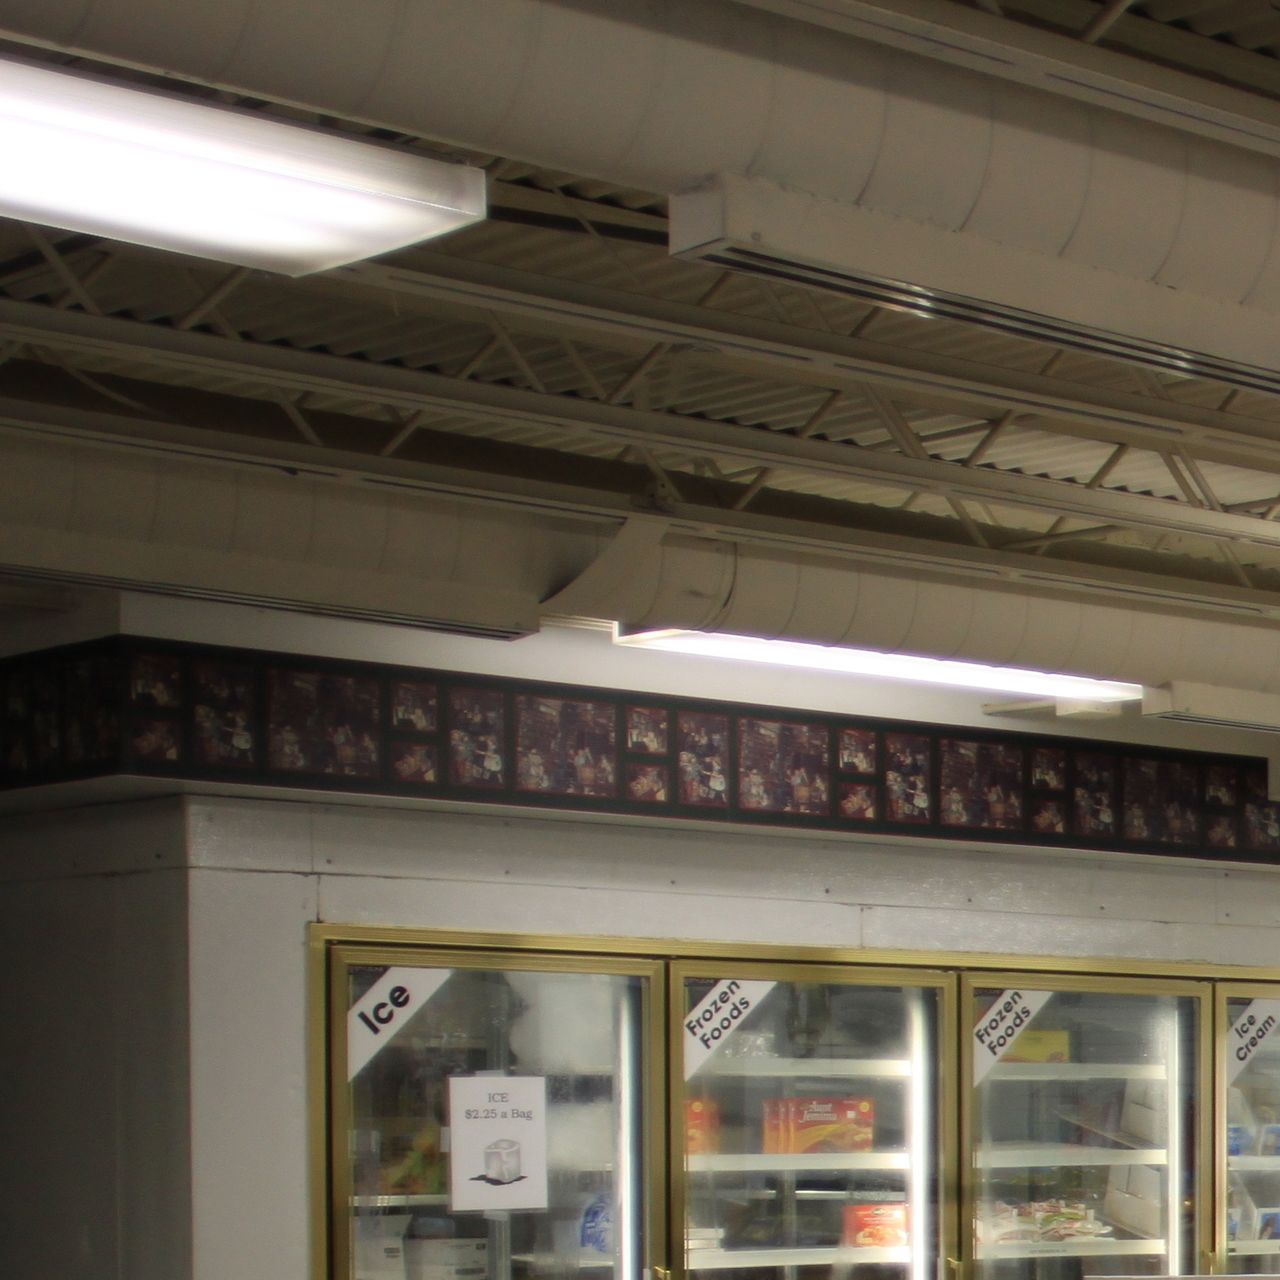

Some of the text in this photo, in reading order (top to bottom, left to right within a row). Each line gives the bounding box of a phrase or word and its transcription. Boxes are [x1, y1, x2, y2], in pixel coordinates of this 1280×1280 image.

[358, 985, 410, 1035] Ice
[685, 980, 741, 1036] Frozen
[699, 996, 750, 1049] Foods
[975, 991, 1022, 1044] Frozen
[987, 1006, 1031, 1056] Foods
[1234, 1014, 1256, 1039] Ice
[1236, 1015, 1276, 1061] Cream
[464, 1109, 532, 1121] $2.25 a Bag
[487, 1092, 509, 1104] ICE
